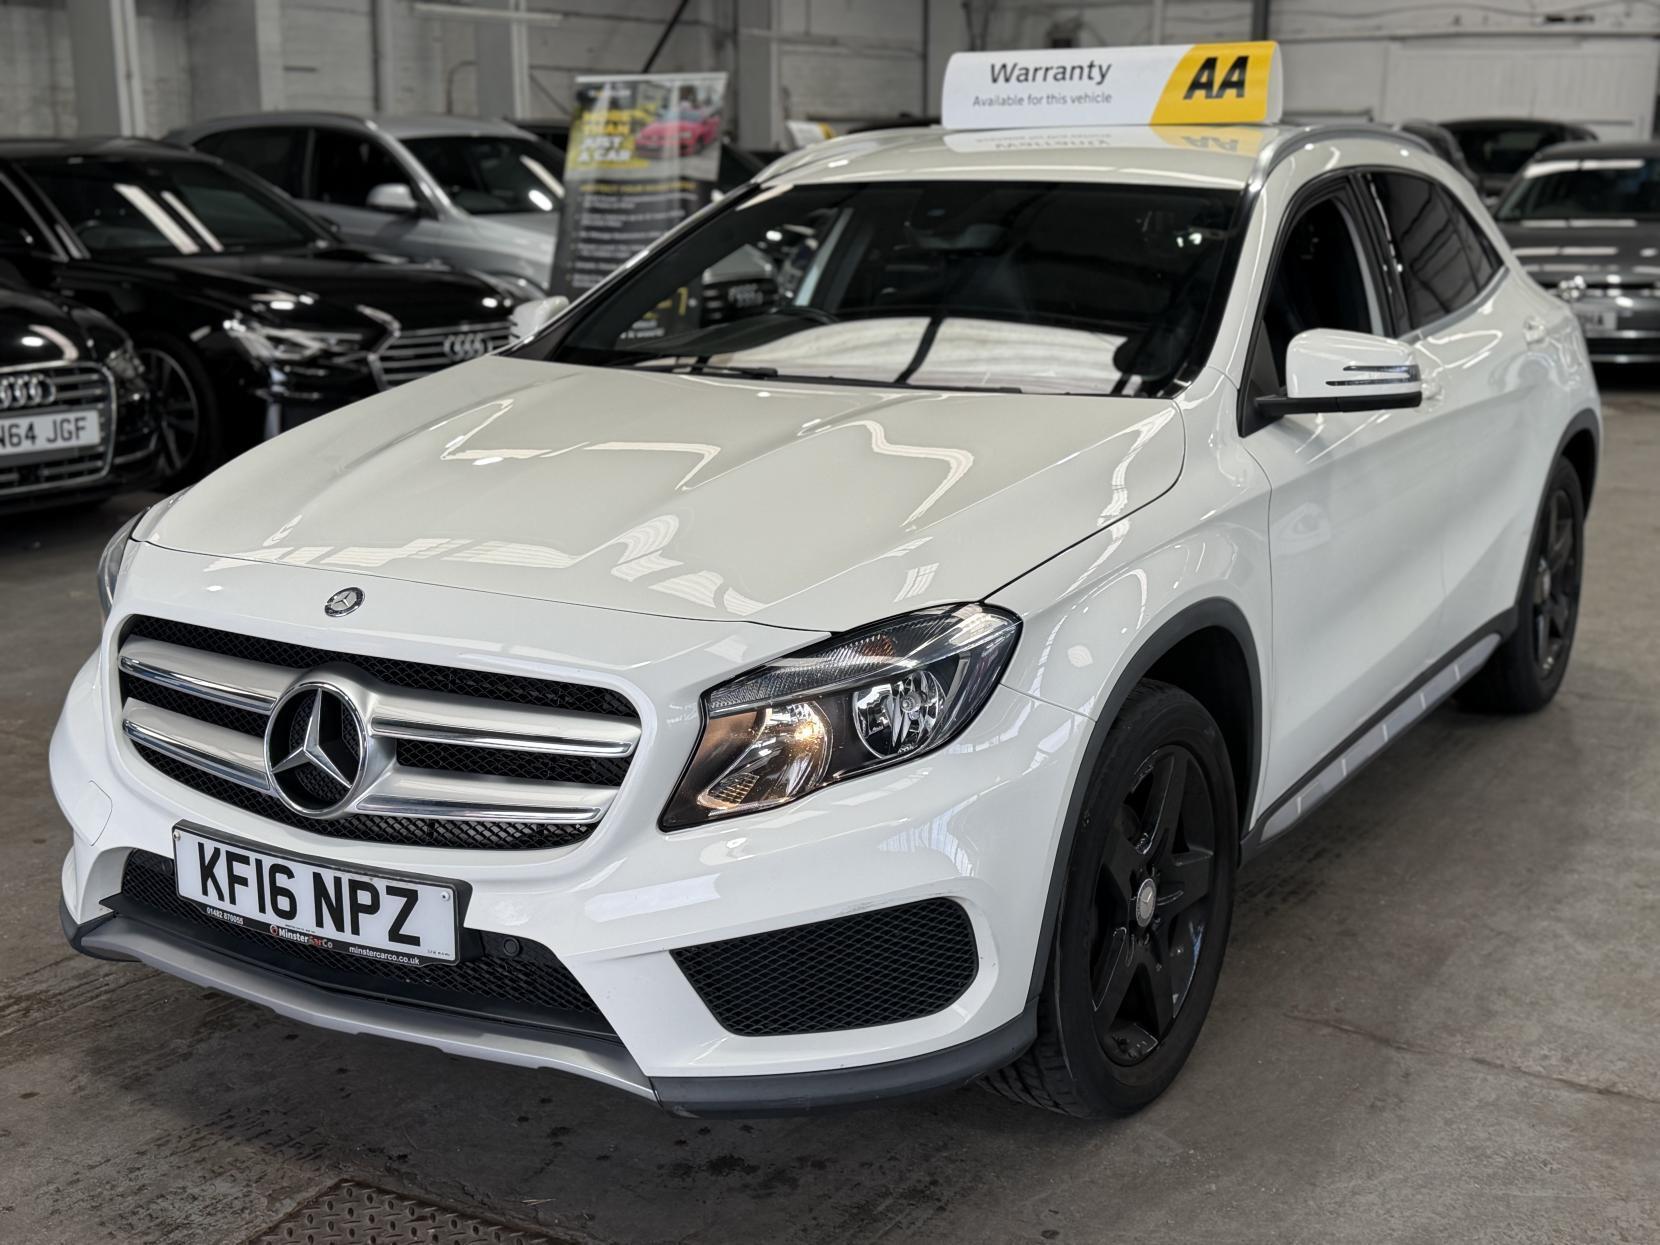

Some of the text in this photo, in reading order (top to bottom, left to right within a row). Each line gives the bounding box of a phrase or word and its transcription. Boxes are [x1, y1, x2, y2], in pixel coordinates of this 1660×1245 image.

[990, 59, 1112, 86] Warranty
[1183, 56, 1250, 100] AA
[972, 91, 1112, 107] Available for this vehicle
[46, 416, 87, 443] JGF
[197, 841, 421, 947] KF16 NPZ
[348, 945, 420, 966] minstercarco.co.uk
